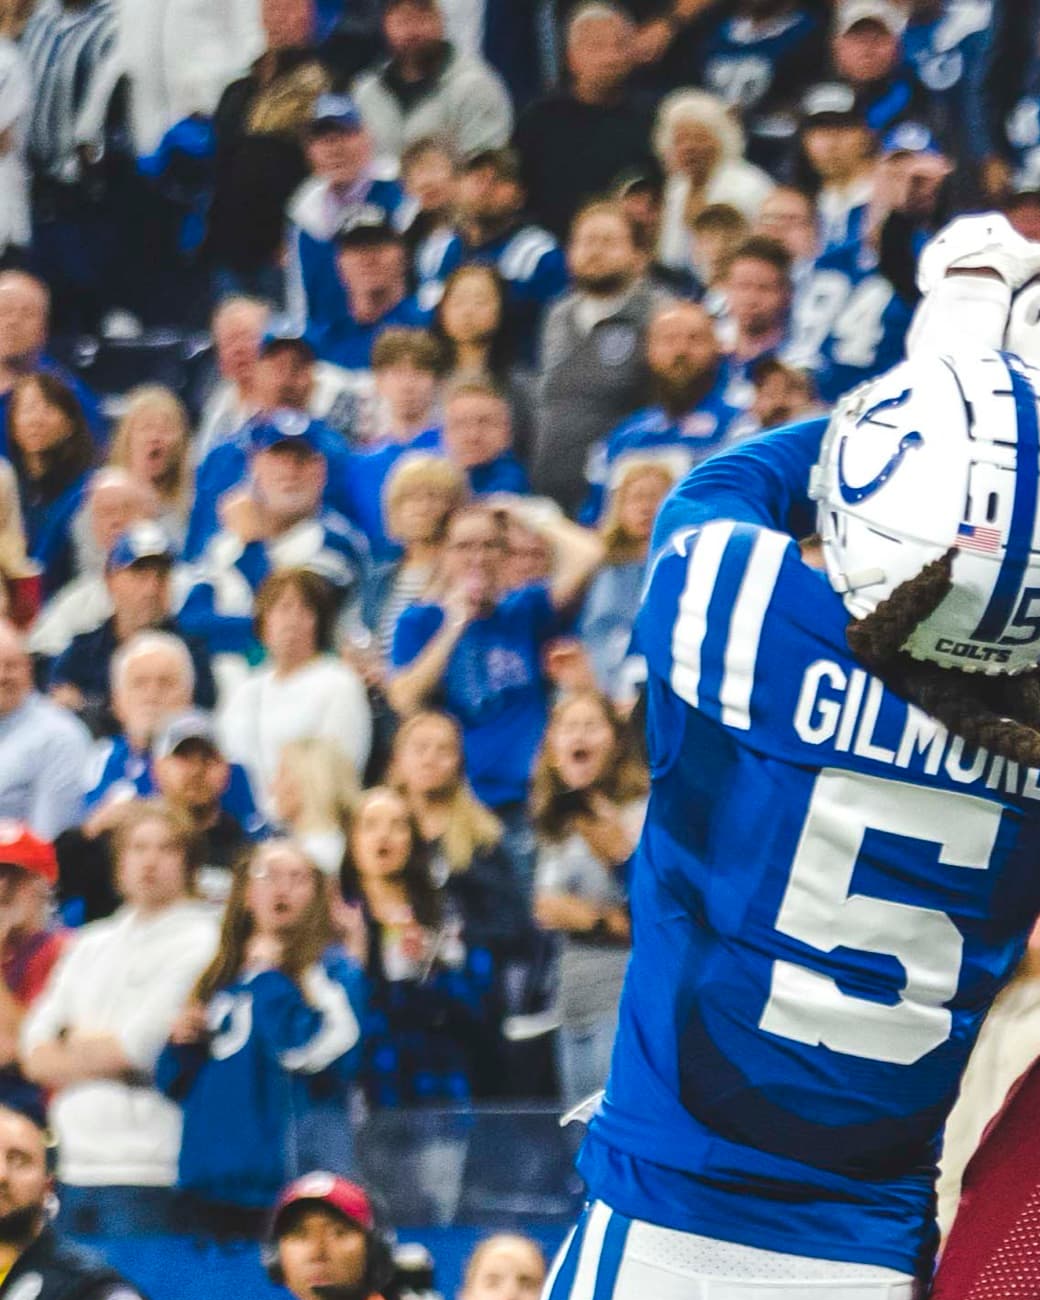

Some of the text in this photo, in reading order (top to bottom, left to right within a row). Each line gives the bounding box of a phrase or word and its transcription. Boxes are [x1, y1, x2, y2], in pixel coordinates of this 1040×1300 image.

[778, 268, 893, 371] 94
[933, 637, 1015, 665] COLTS
[758, 767, 1004, 1065] 5
